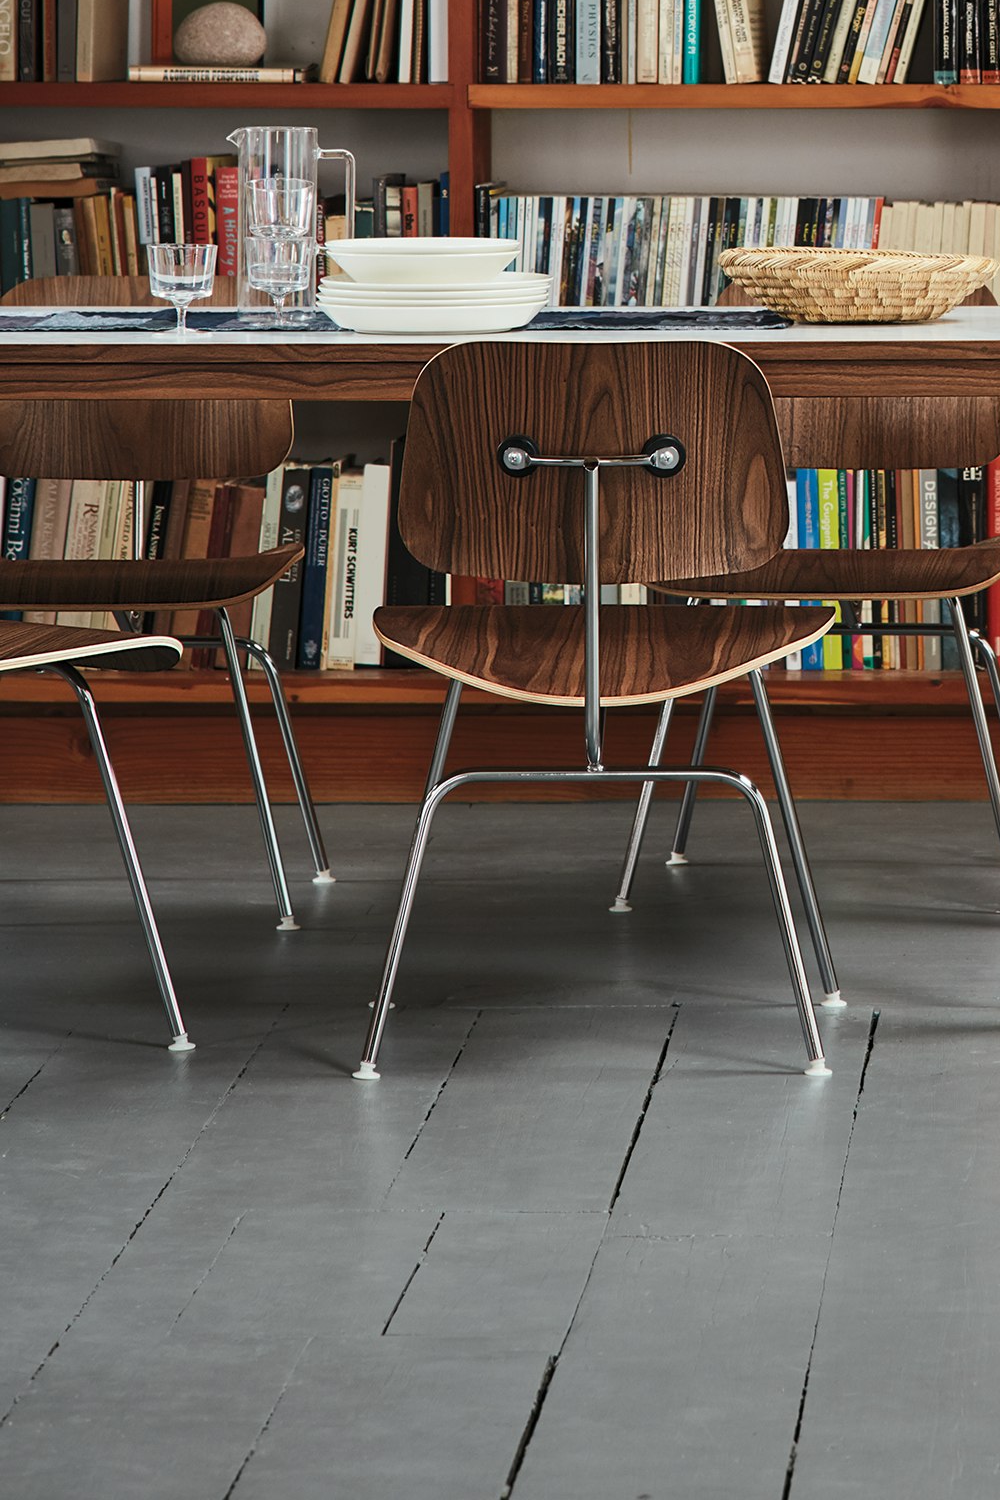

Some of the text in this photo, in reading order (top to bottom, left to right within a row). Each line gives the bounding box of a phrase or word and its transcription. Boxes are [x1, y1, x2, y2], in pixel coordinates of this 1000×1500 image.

[522, 0, 531, 24] SPACE
[852, 6, 866, 33] Burger
[588, 3, 598, 59] PHYSICS
[688, 35, 697, 45] OF
[688, 45, 697, 55] PI
[222, 207, 238, 265] A History
[822, 480, 833, 501] The
[152, 505, 165, 531] INSULA
[317, 477, 331, 566] GIOTTO DÜRER
[924, 480, 938, 537] DESIGN
[344, 527, 358, 619] KURT SCHWITTERS
